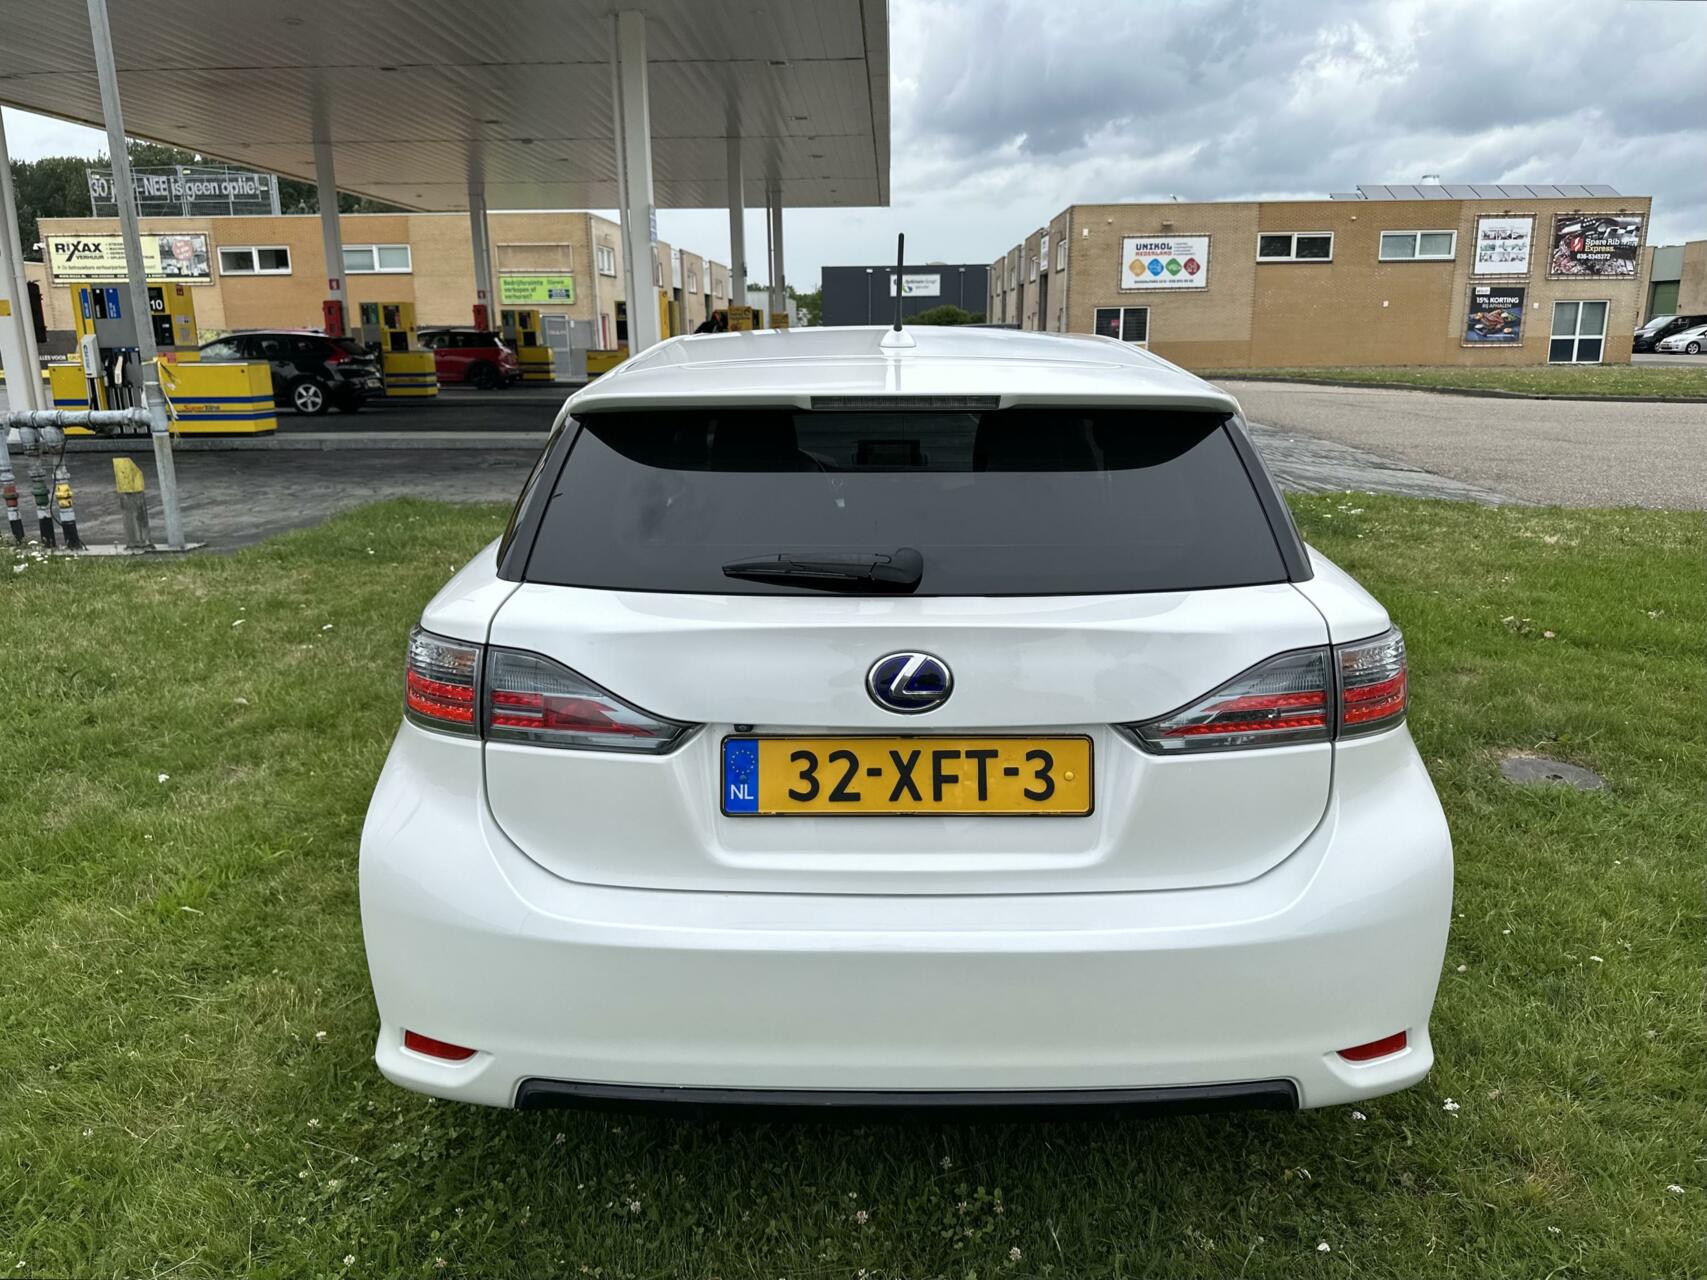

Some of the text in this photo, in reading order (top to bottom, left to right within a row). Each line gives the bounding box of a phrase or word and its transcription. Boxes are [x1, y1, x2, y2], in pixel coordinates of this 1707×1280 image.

[91, 179, 107, 197] 30
[171, 177, 183, 196] is
[185, 181, 219, 201] geen
[1585, 238, 1606, 246] Spare
[55, 240, 103, 262] RIXAX
[150, 299, 163, 311] 10
[1489, 296, 1519, 304] KORTING
[788, 750, 1055, 802] 32-XFT-3
[730, 784, 754, 801] NL
